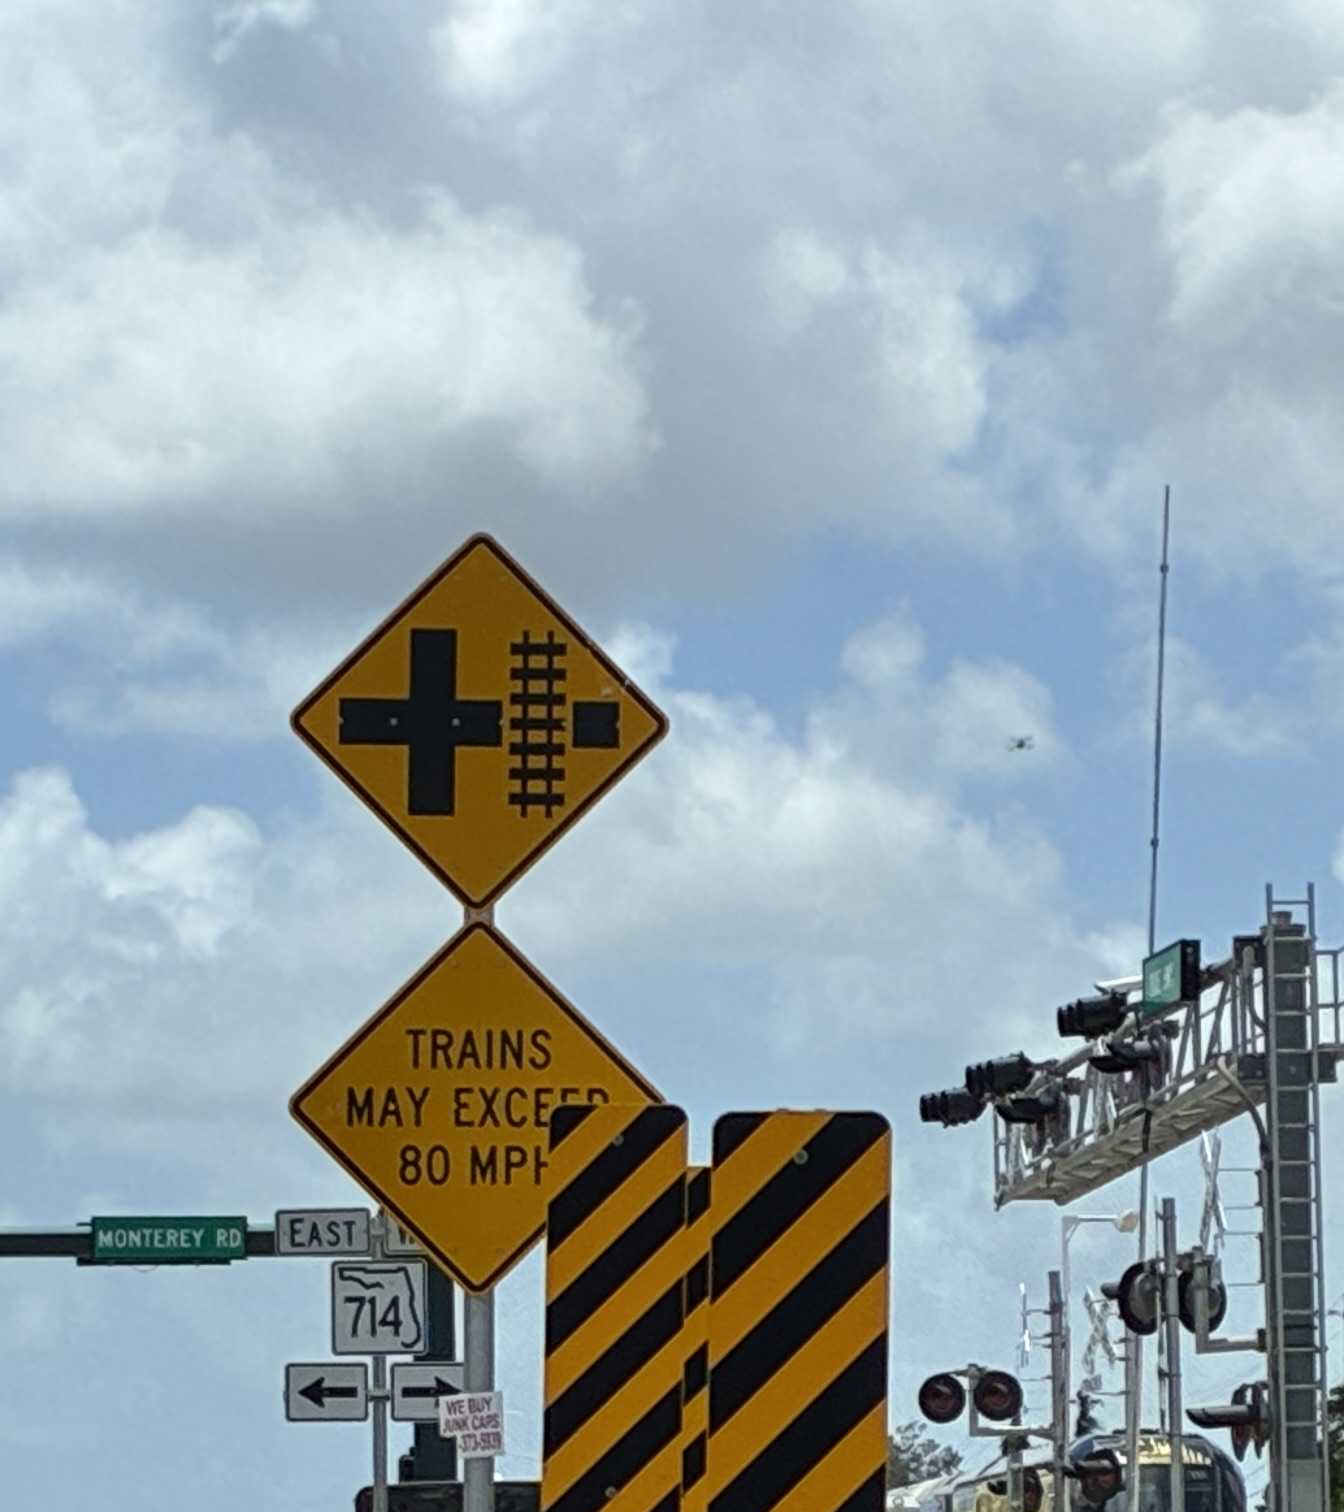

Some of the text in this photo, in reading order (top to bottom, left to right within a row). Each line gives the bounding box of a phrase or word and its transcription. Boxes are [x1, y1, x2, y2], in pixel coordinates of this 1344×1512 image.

[406, 1029, 552, 1070] TRAINS
[346, 1087, 430, 1128] MAY
[399, 1145, 450, 1185] 80
[98, 1229, 241, 1248] MONTEREY RD
[289, 1219, 356, 1247] EAST
[344, 1295, 403, 1337] 714
[447, 1400, 465, 1416] WE
